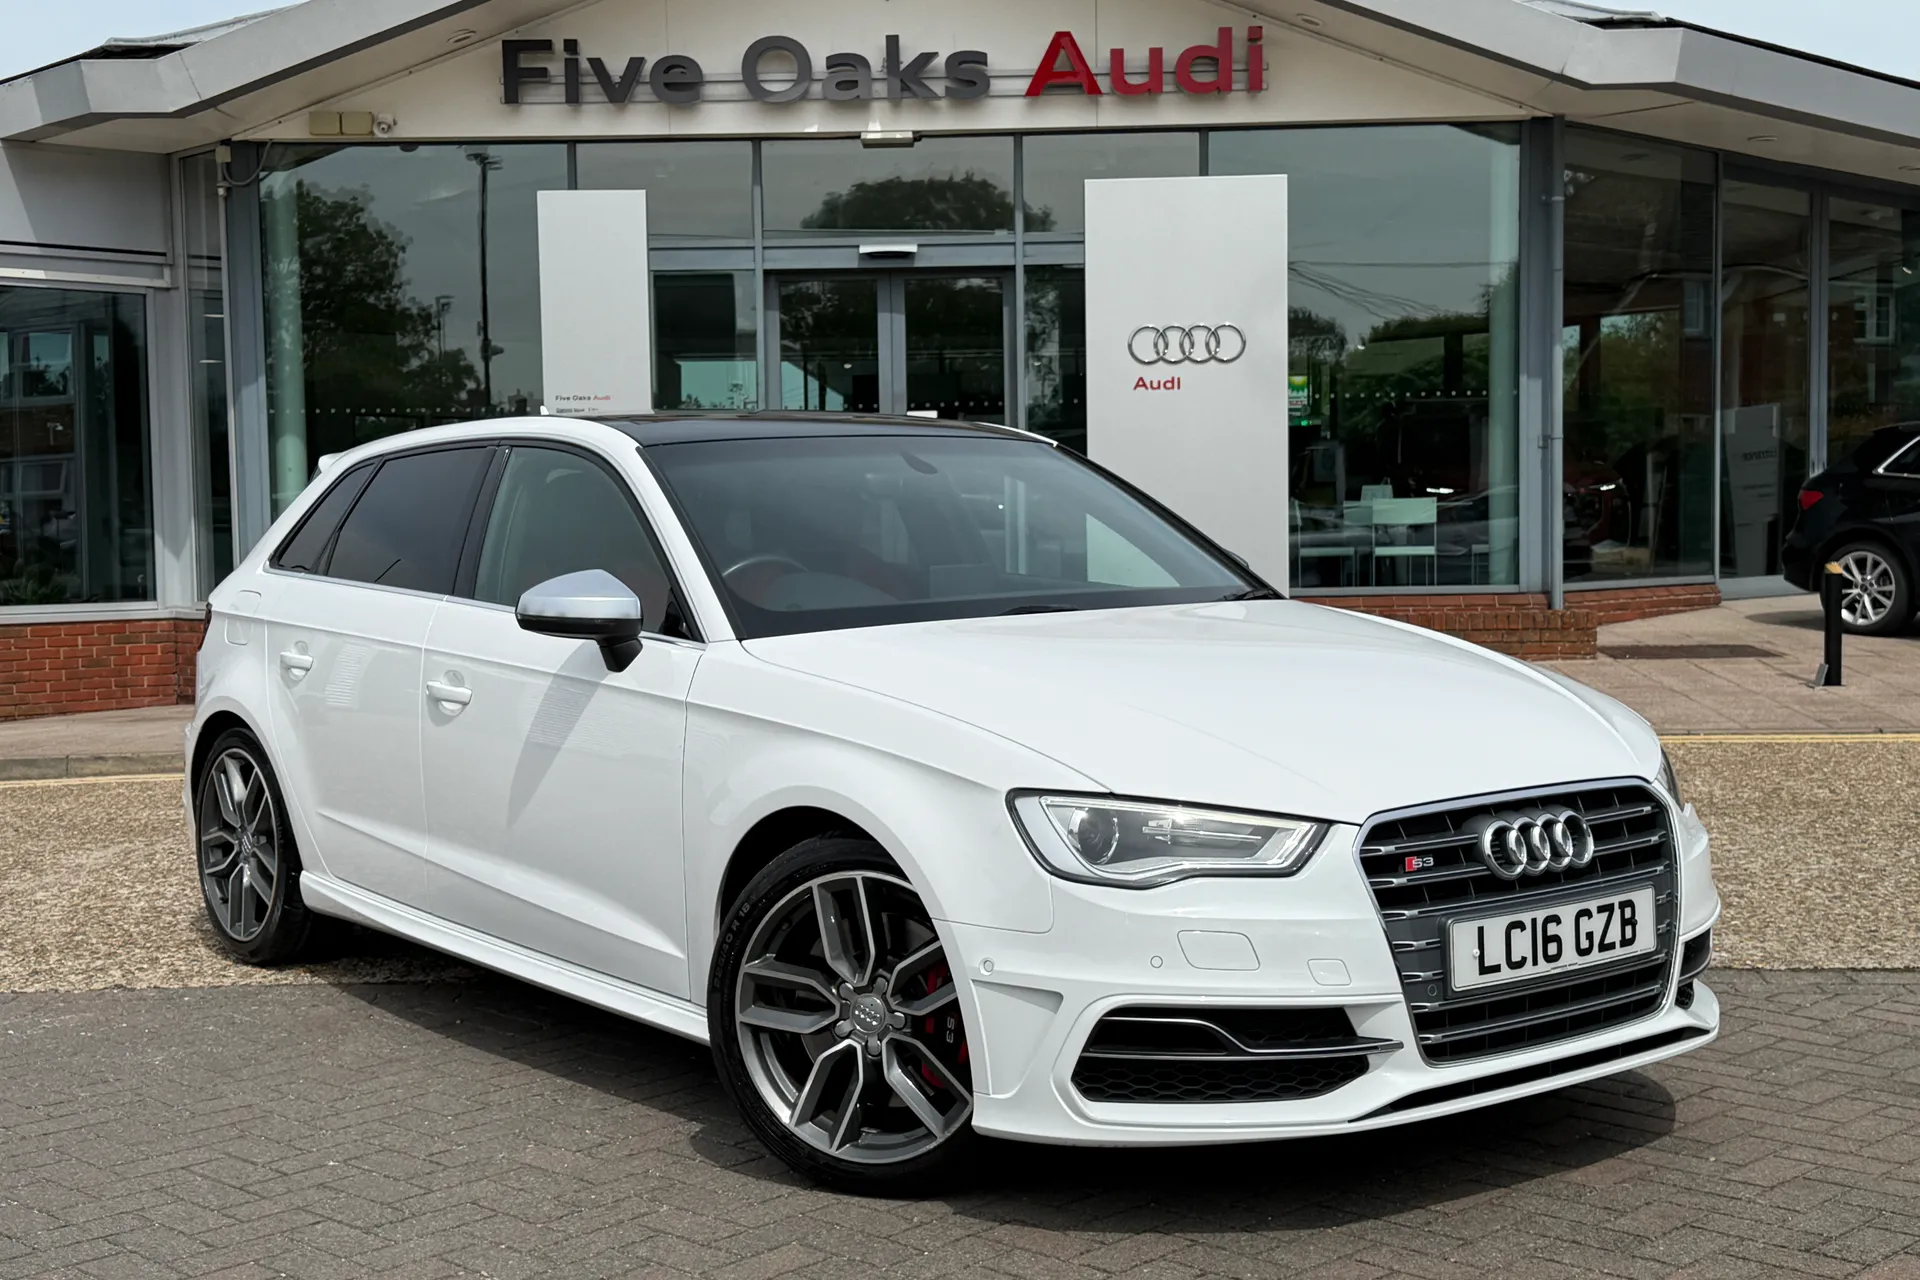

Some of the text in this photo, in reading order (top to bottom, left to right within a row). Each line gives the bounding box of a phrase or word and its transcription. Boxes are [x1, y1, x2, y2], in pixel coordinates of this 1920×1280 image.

[502, 26, 1264, 105] Five Oaks Audi
[1133, 376, 1181, 391] Audi
[1411, 857, 1434, 869] S3
[1477, 899, 1638, 976] LC16 GZB
[945, 1016, 956, 1044] S3
